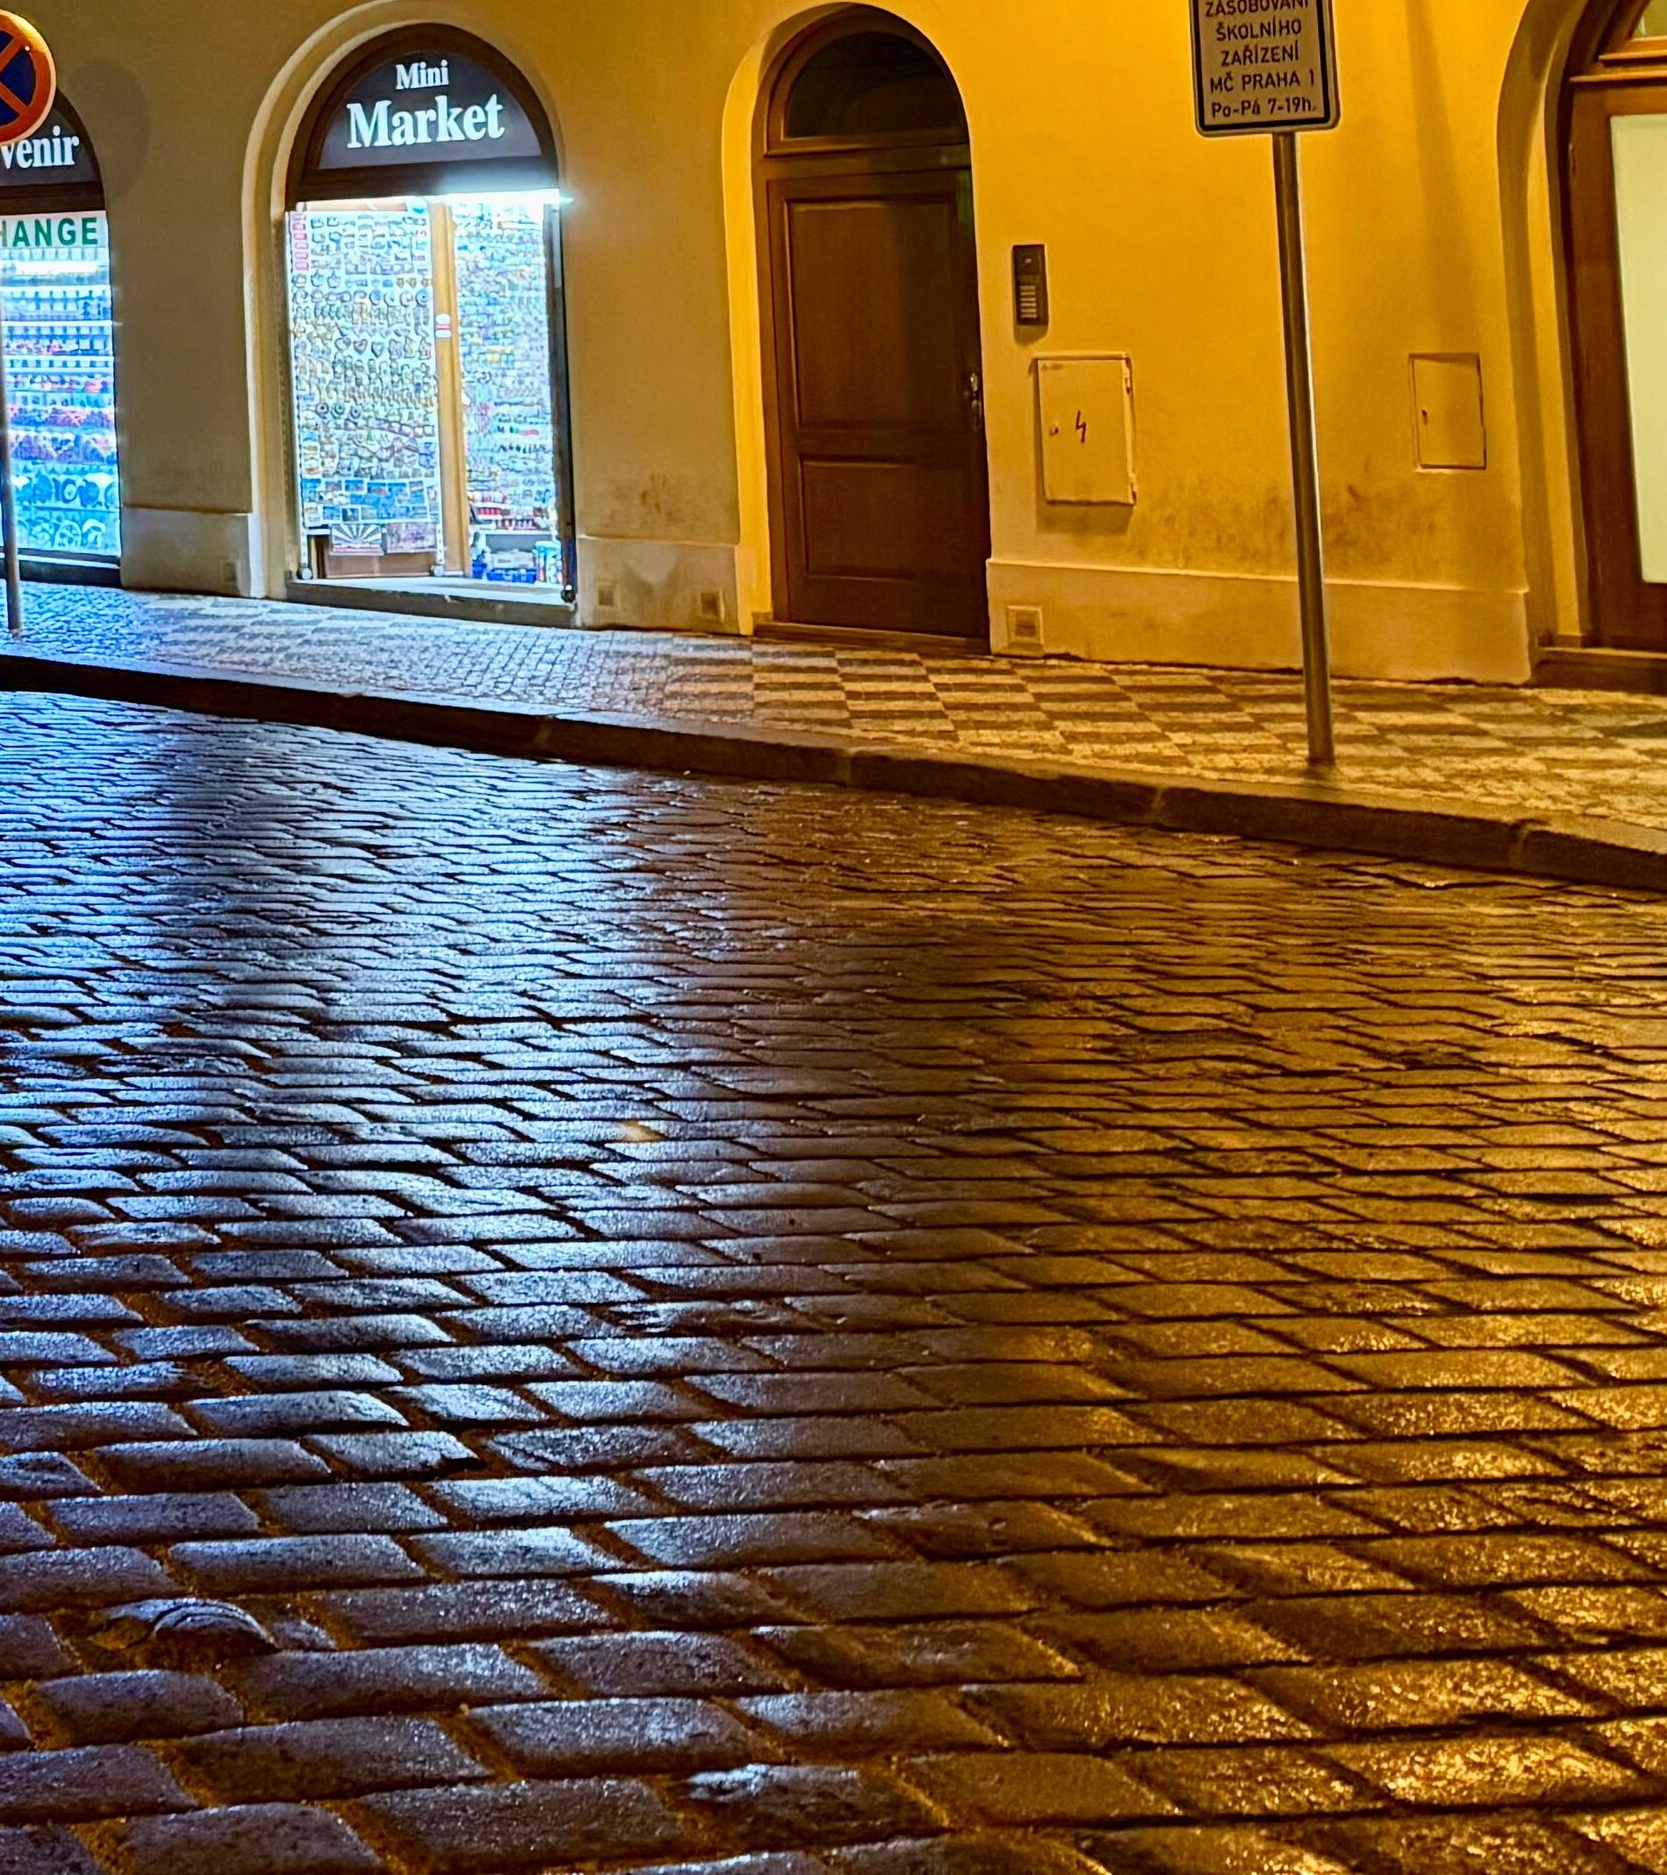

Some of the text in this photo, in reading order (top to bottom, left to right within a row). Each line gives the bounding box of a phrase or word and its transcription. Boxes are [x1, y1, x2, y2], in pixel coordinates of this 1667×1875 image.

[1216, 15, 1302, 42] ŠKOLNÍHO
[1220, 39, 1299, 68] ZAŘÍZENÍ
[395, 59, 450, 90] Mini
[1210, 68, 1315, 93] MČ PRAHA 1
[346, 93, 506, 149] Market
[1211, 98, 1261, 118] Po-Pá
